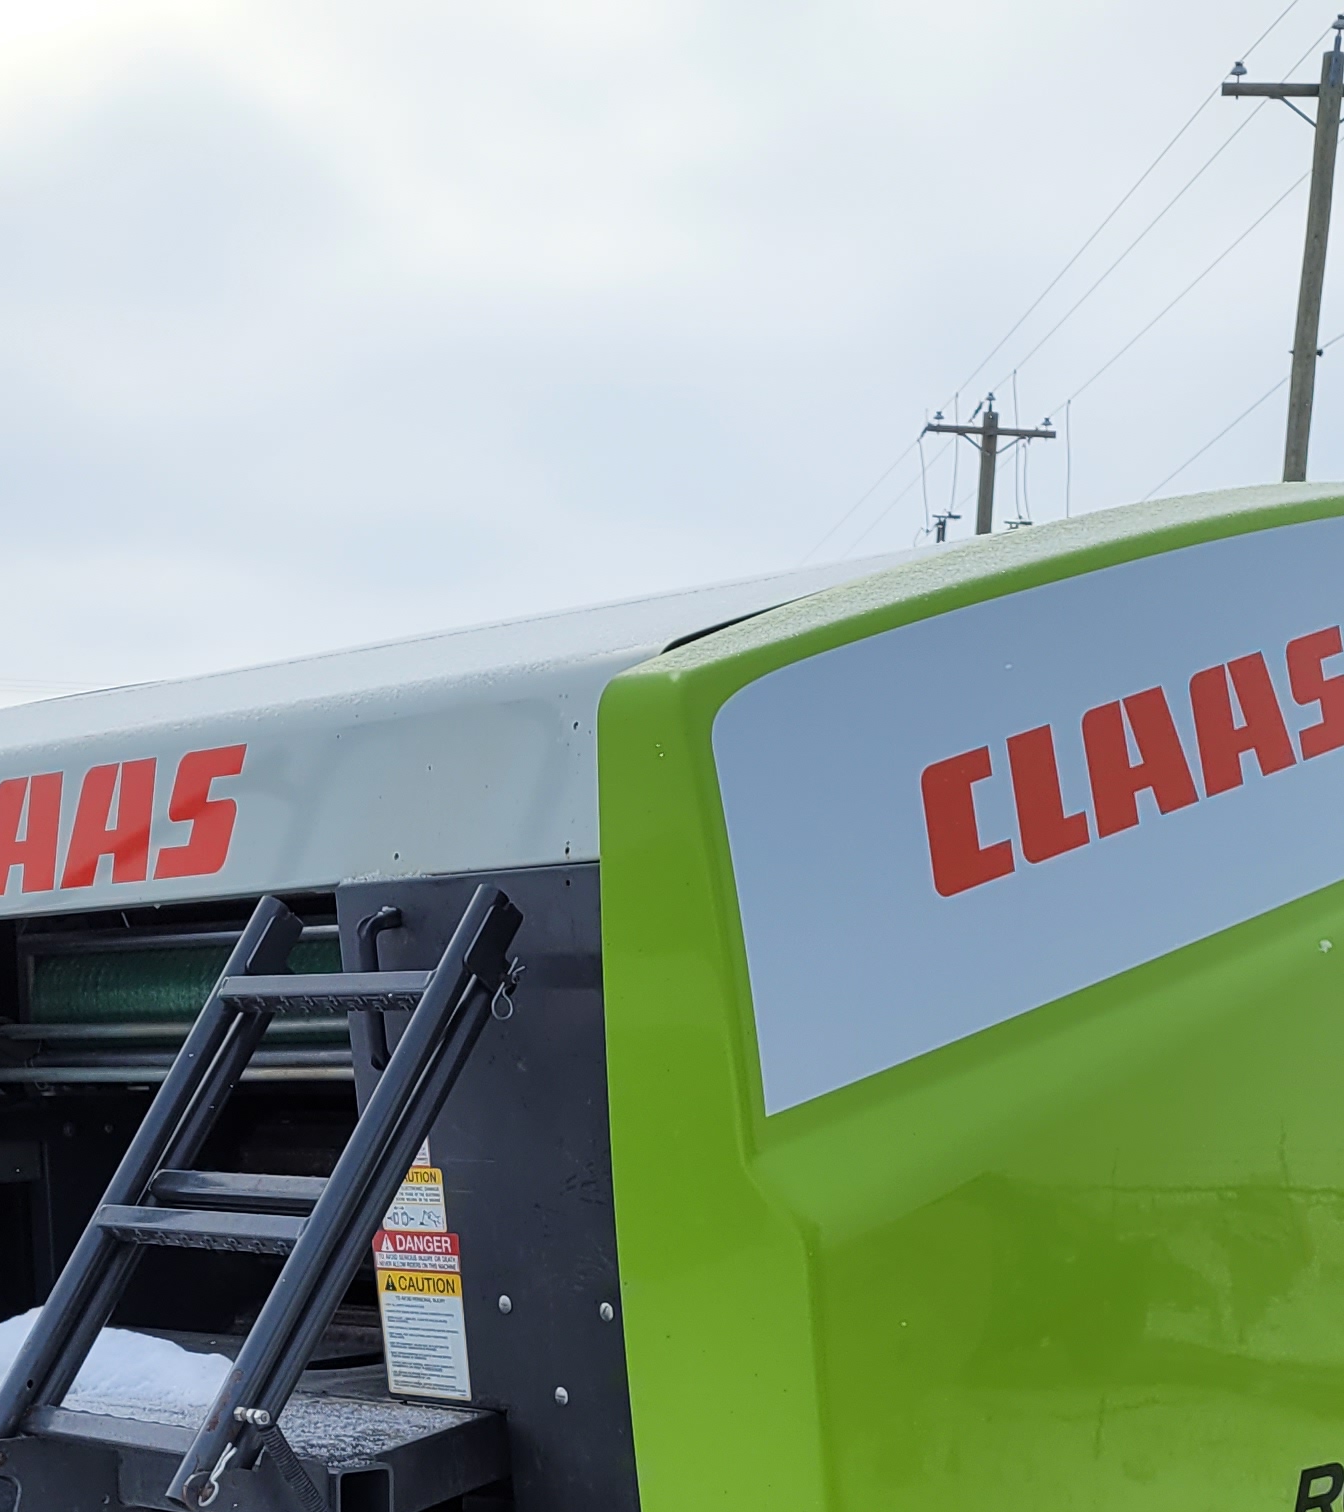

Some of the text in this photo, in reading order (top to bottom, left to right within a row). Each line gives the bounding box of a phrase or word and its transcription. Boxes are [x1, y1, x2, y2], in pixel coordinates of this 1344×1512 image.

[406, 1171, 436, 1183] UTION
[395, 1234, 451, 1252] DANGER
[397, 1275, 455, 1296] CAUTION
